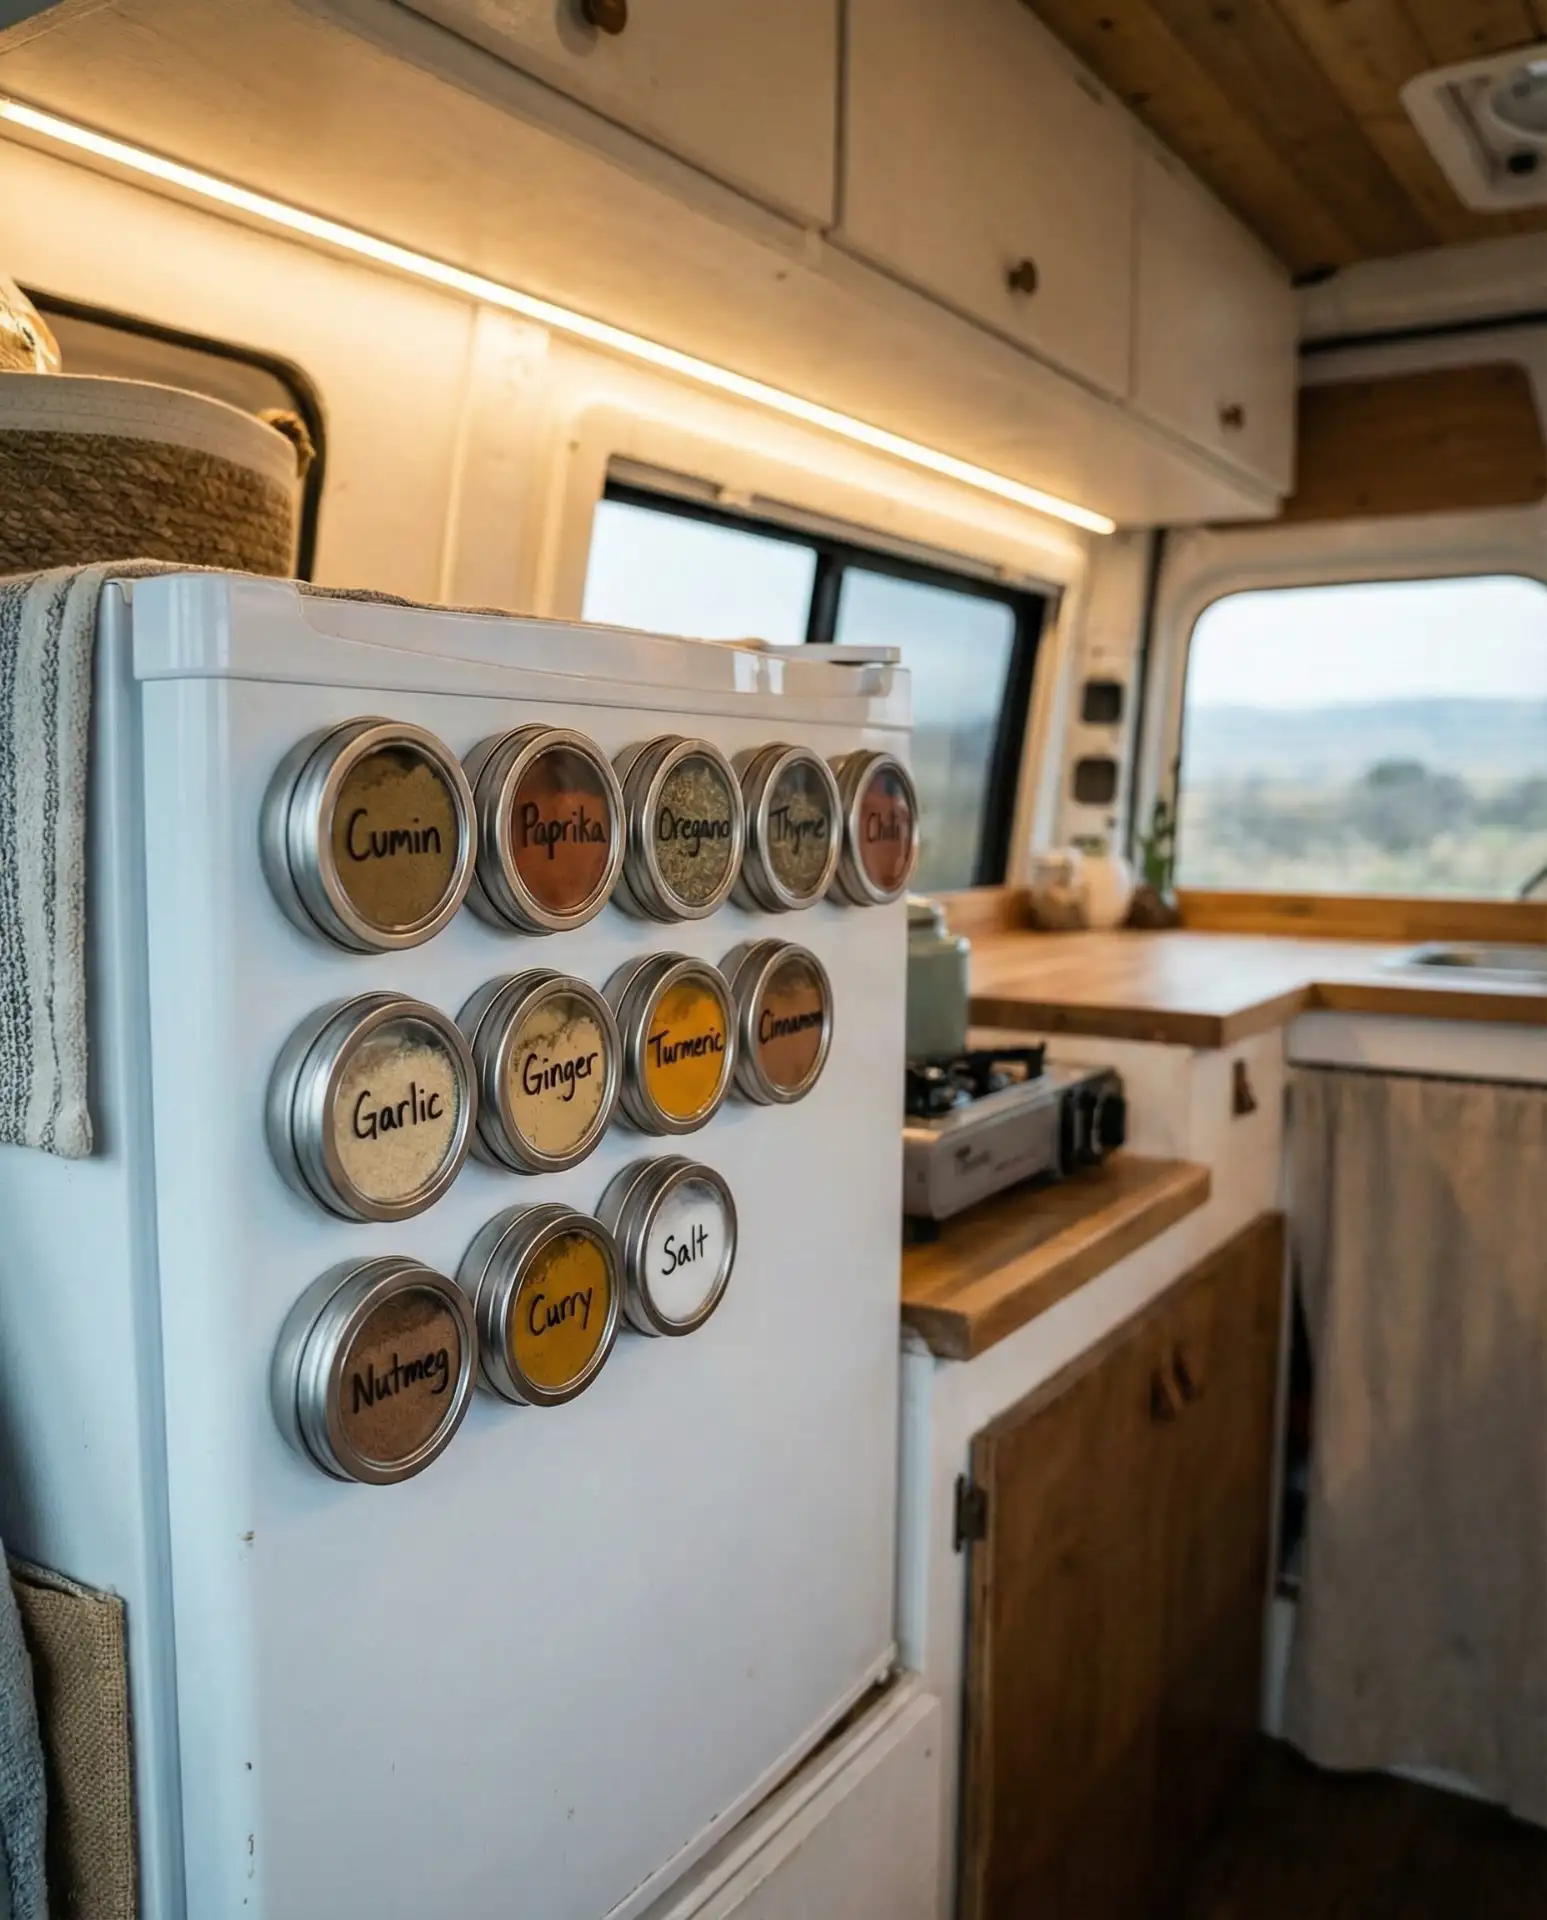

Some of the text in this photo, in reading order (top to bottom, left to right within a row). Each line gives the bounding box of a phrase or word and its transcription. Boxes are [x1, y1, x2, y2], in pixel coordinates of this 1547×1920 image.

[347, 808, 441, 862] Cumin
[521, 802, 606, 860] Paprika
[659, 806, 730, 857] Oregano
[769, 806, 825, 856] Thyme
[648, 1027, 724, 1068] Turmeric
[523, 1052, 598, 1102] Ginger
[353, 1081, 444, 1140] Garlic
[661, 1224, 708, 1276] Salt
[529, 1287, 592, 1337] Curry
[353, 1347, 449, 1413] Nutmeg
